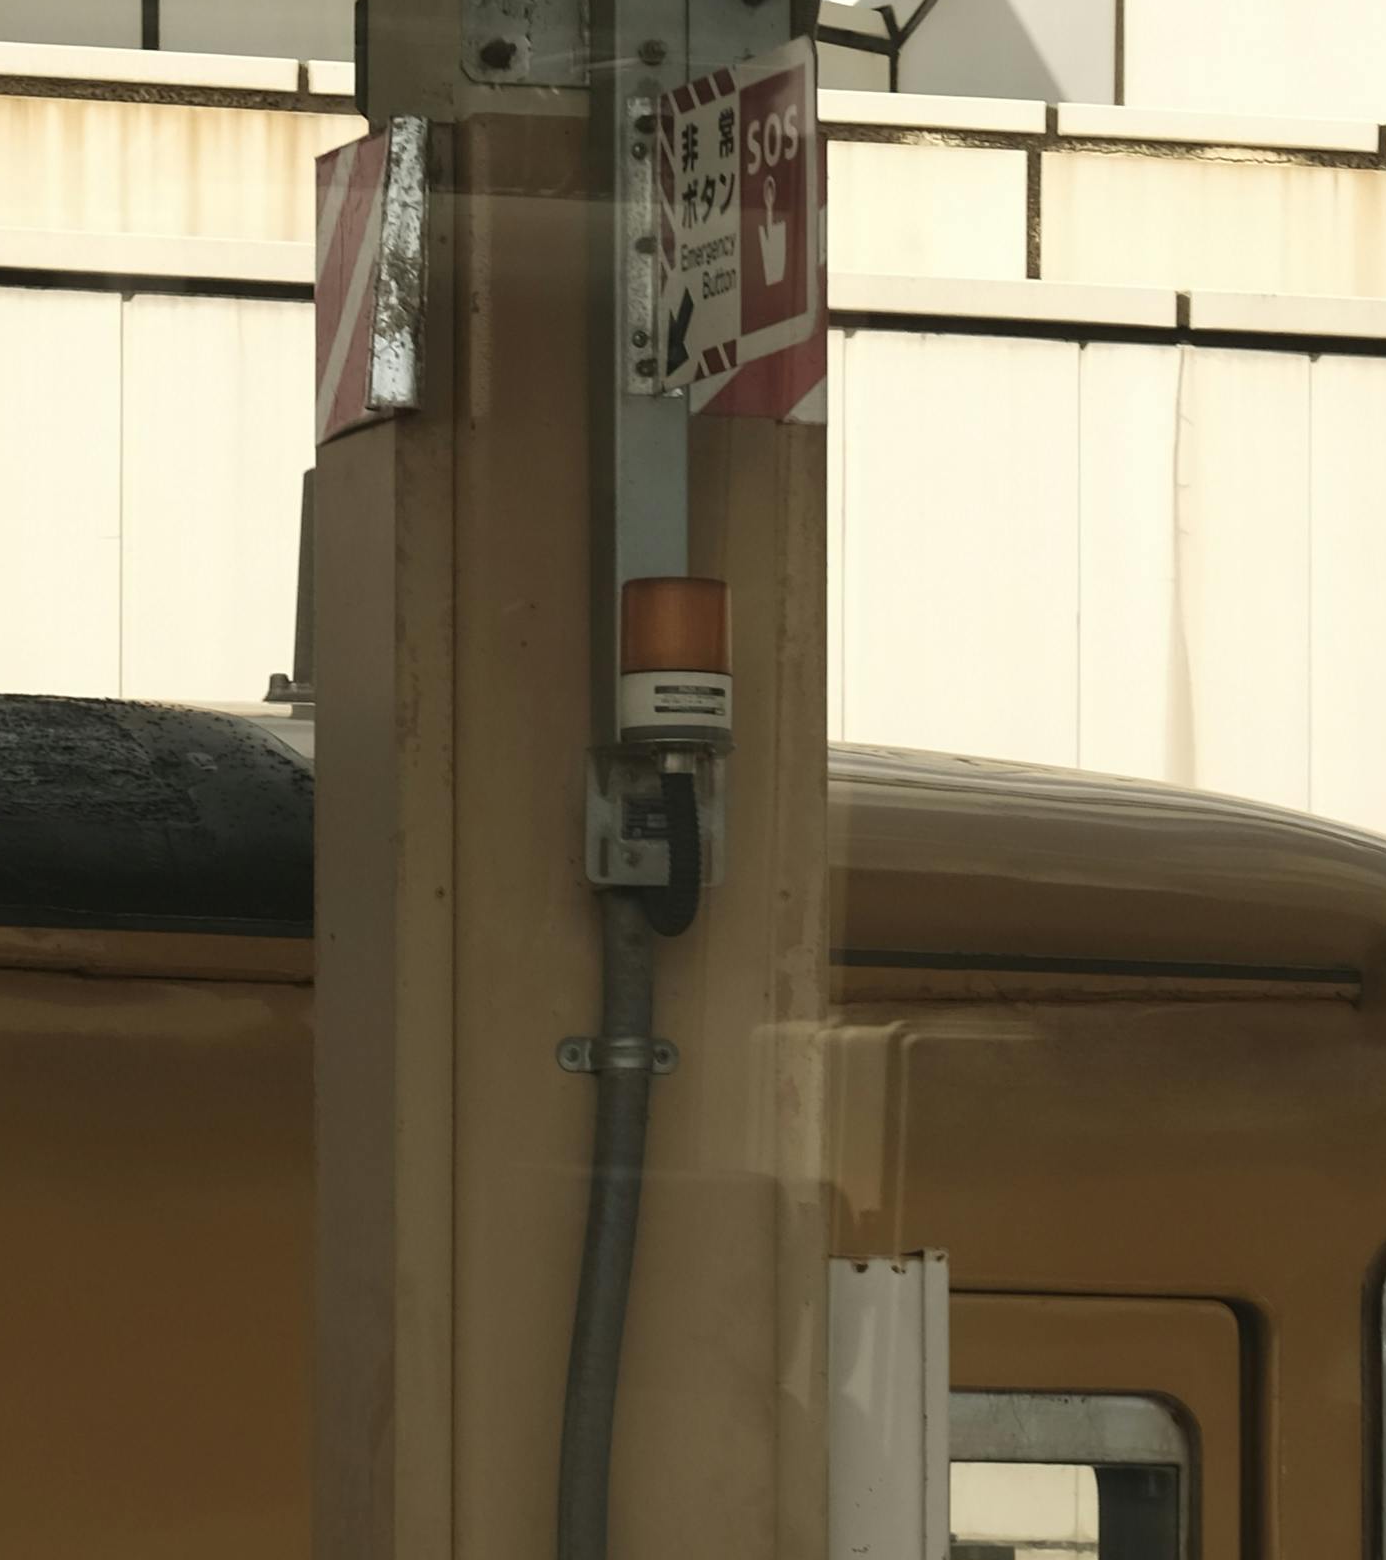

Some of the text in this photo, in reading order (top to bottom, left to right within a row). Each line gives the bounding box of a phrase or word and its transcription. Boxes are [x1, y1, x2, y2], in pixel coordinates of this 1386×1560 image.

[681, 106, 734, 174] 非常
[746, 103, 799, 176] SOS
[681, 173, 735, 229] ボタン
[681, 232, 737, 272] Emergency
[702, 268, 737, 300] Button
